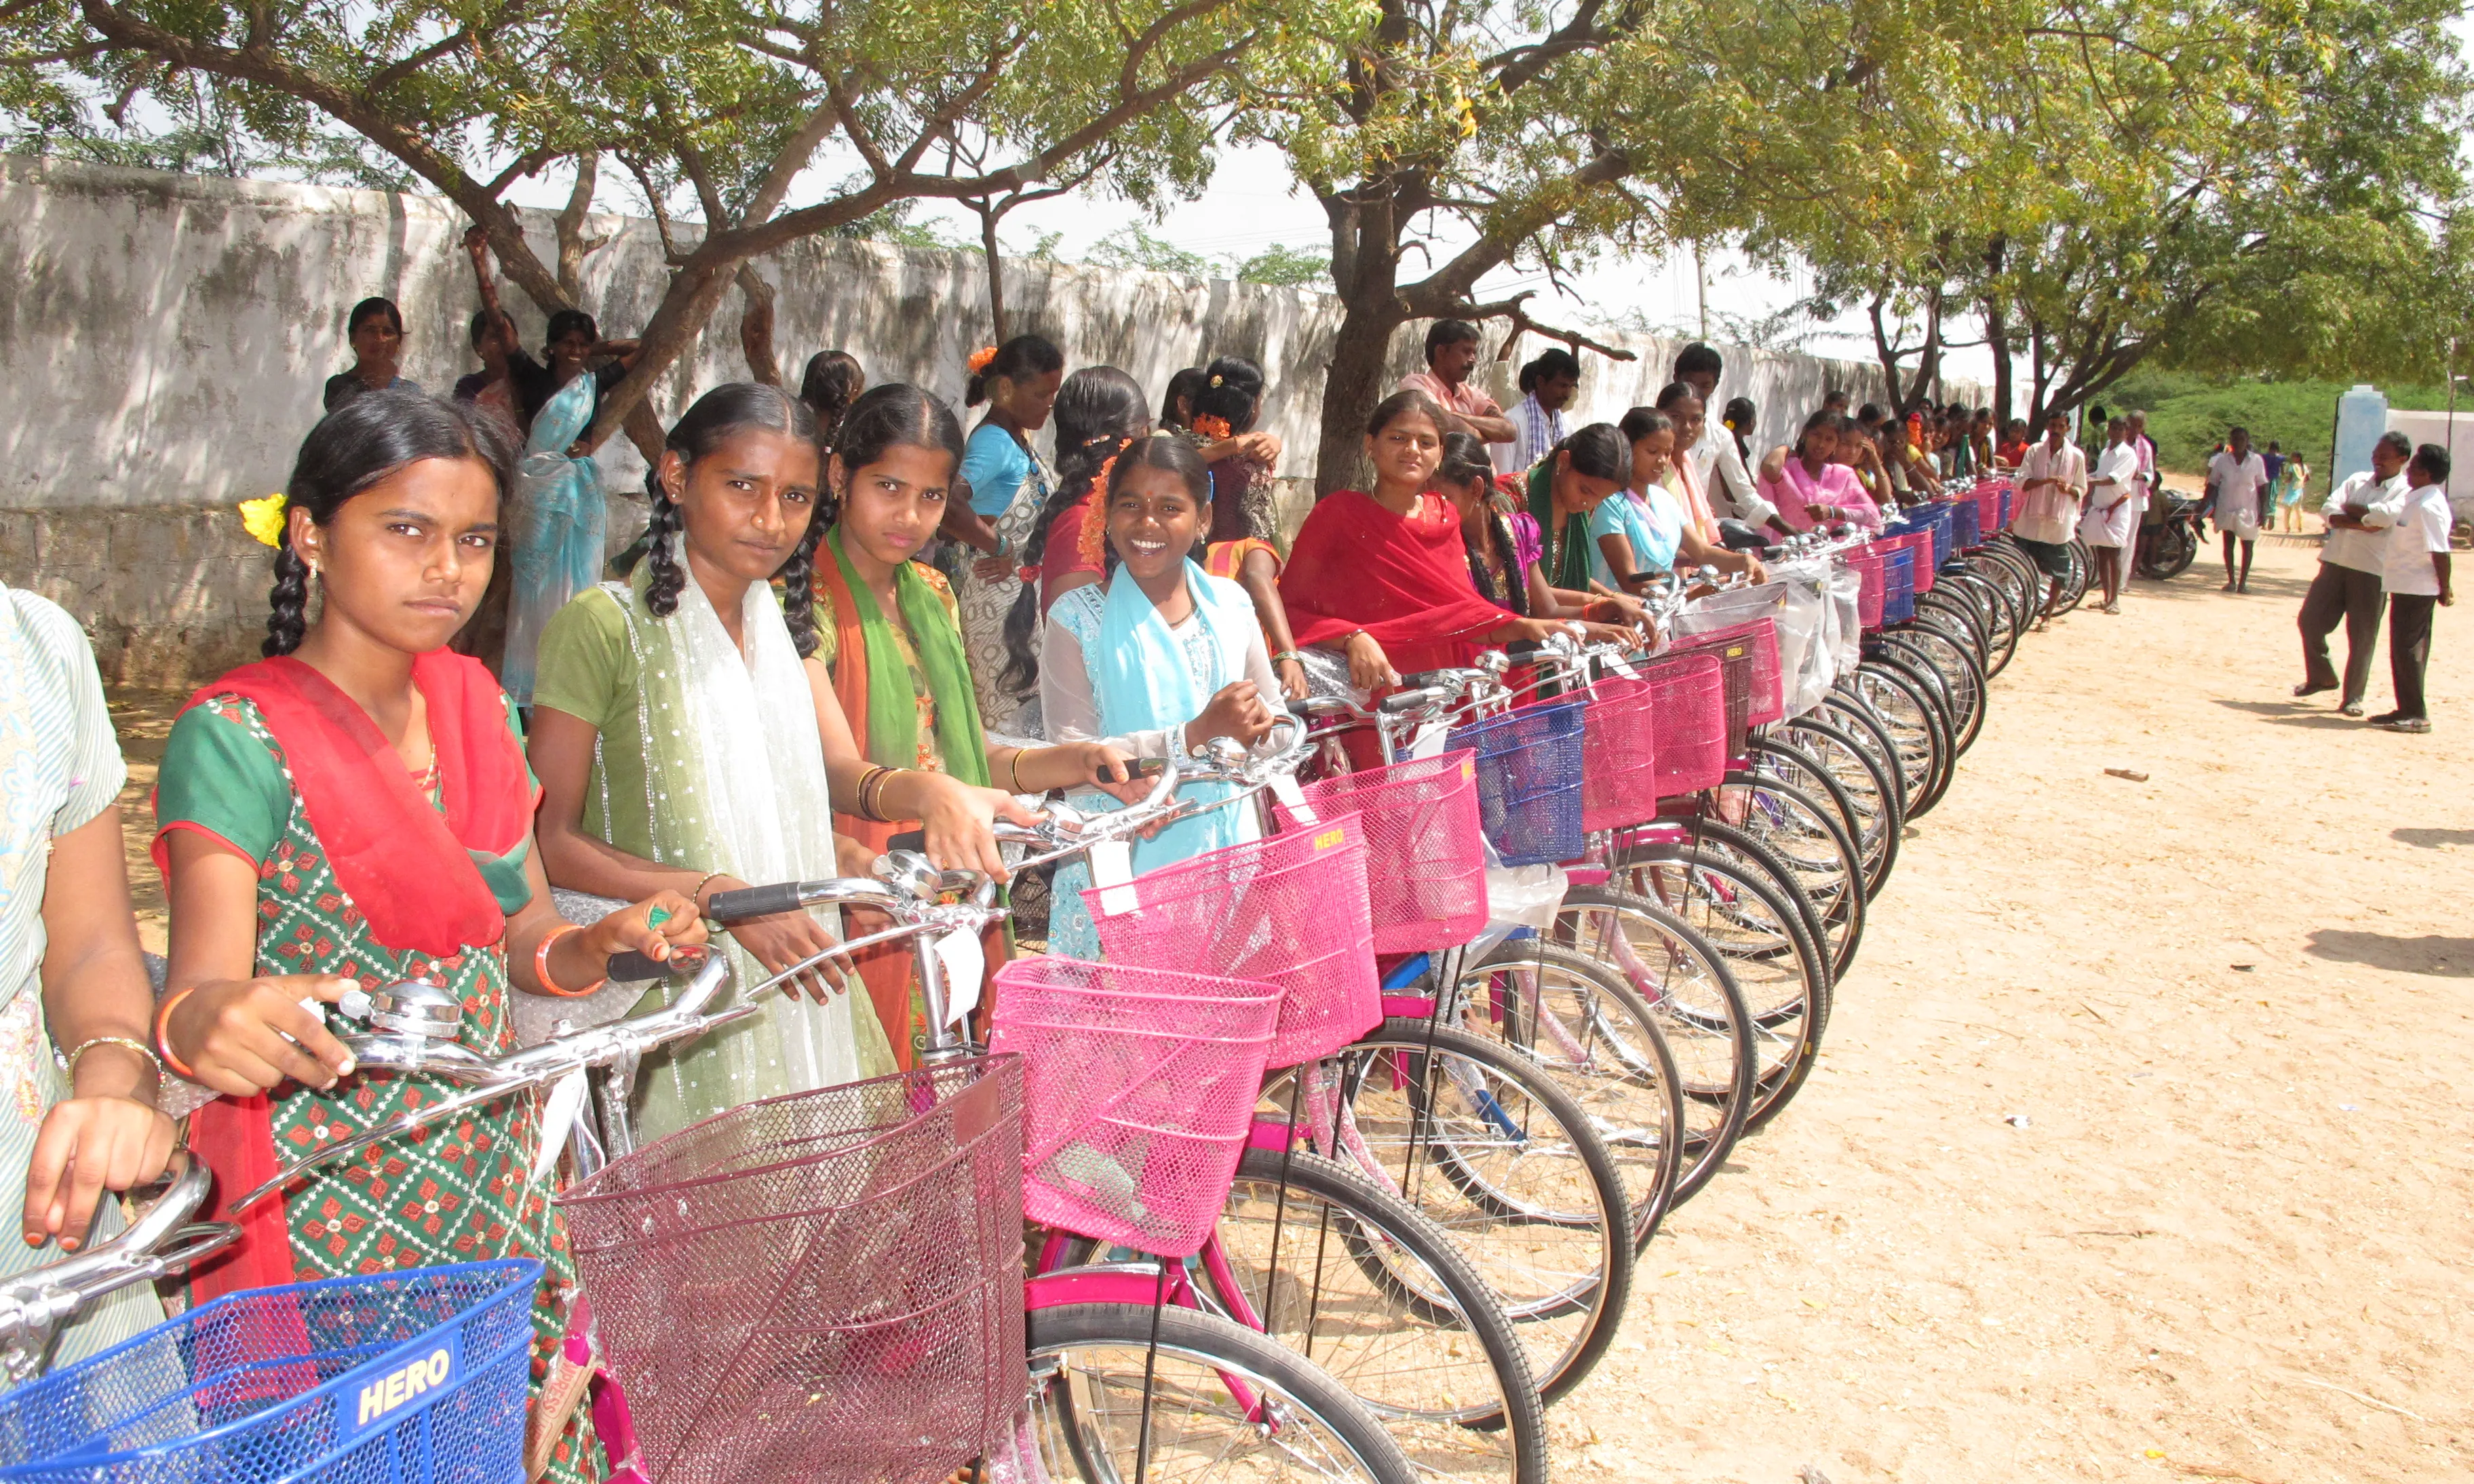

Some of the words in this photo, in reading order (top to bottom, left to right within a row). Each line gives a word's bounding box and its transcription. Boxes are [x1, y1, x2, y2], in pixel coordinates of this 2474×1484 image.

[1314, 828, 1343, 851] HERO
[358, 1348, 450, 1426] HERO
[542, 1360, 580, 1413] MPRESS
